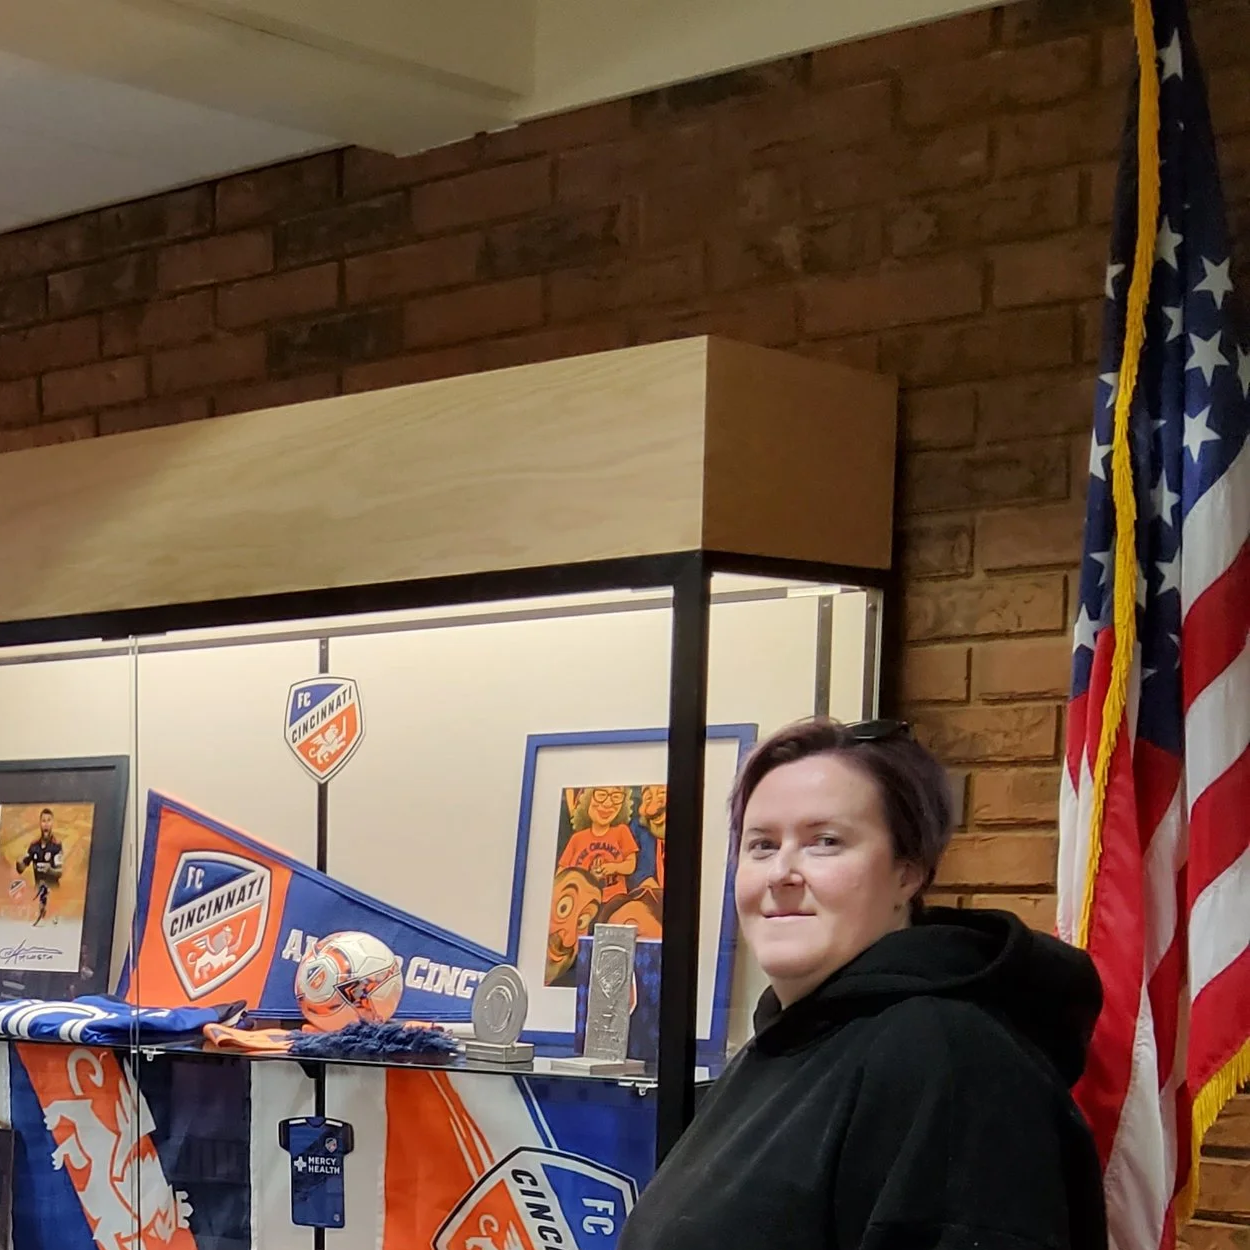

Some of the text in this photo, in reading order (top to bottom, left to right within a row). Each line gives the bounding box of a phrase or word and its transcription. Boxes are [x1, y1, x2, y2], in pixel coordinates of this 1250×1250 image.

[292, 685, 352, 744] CINCINNATI
[297, 692, 311, 709] FC
[184, 866, 205, 889] FC
[170, 876, 264, 937] CINCINNATI
[405, 956, 488, 998] CINC
[308, 1156, 337, 1165] MERCY
[308, 1166, 340, 1174] HEALTH
[582, 1198, 614, 1235] FC
